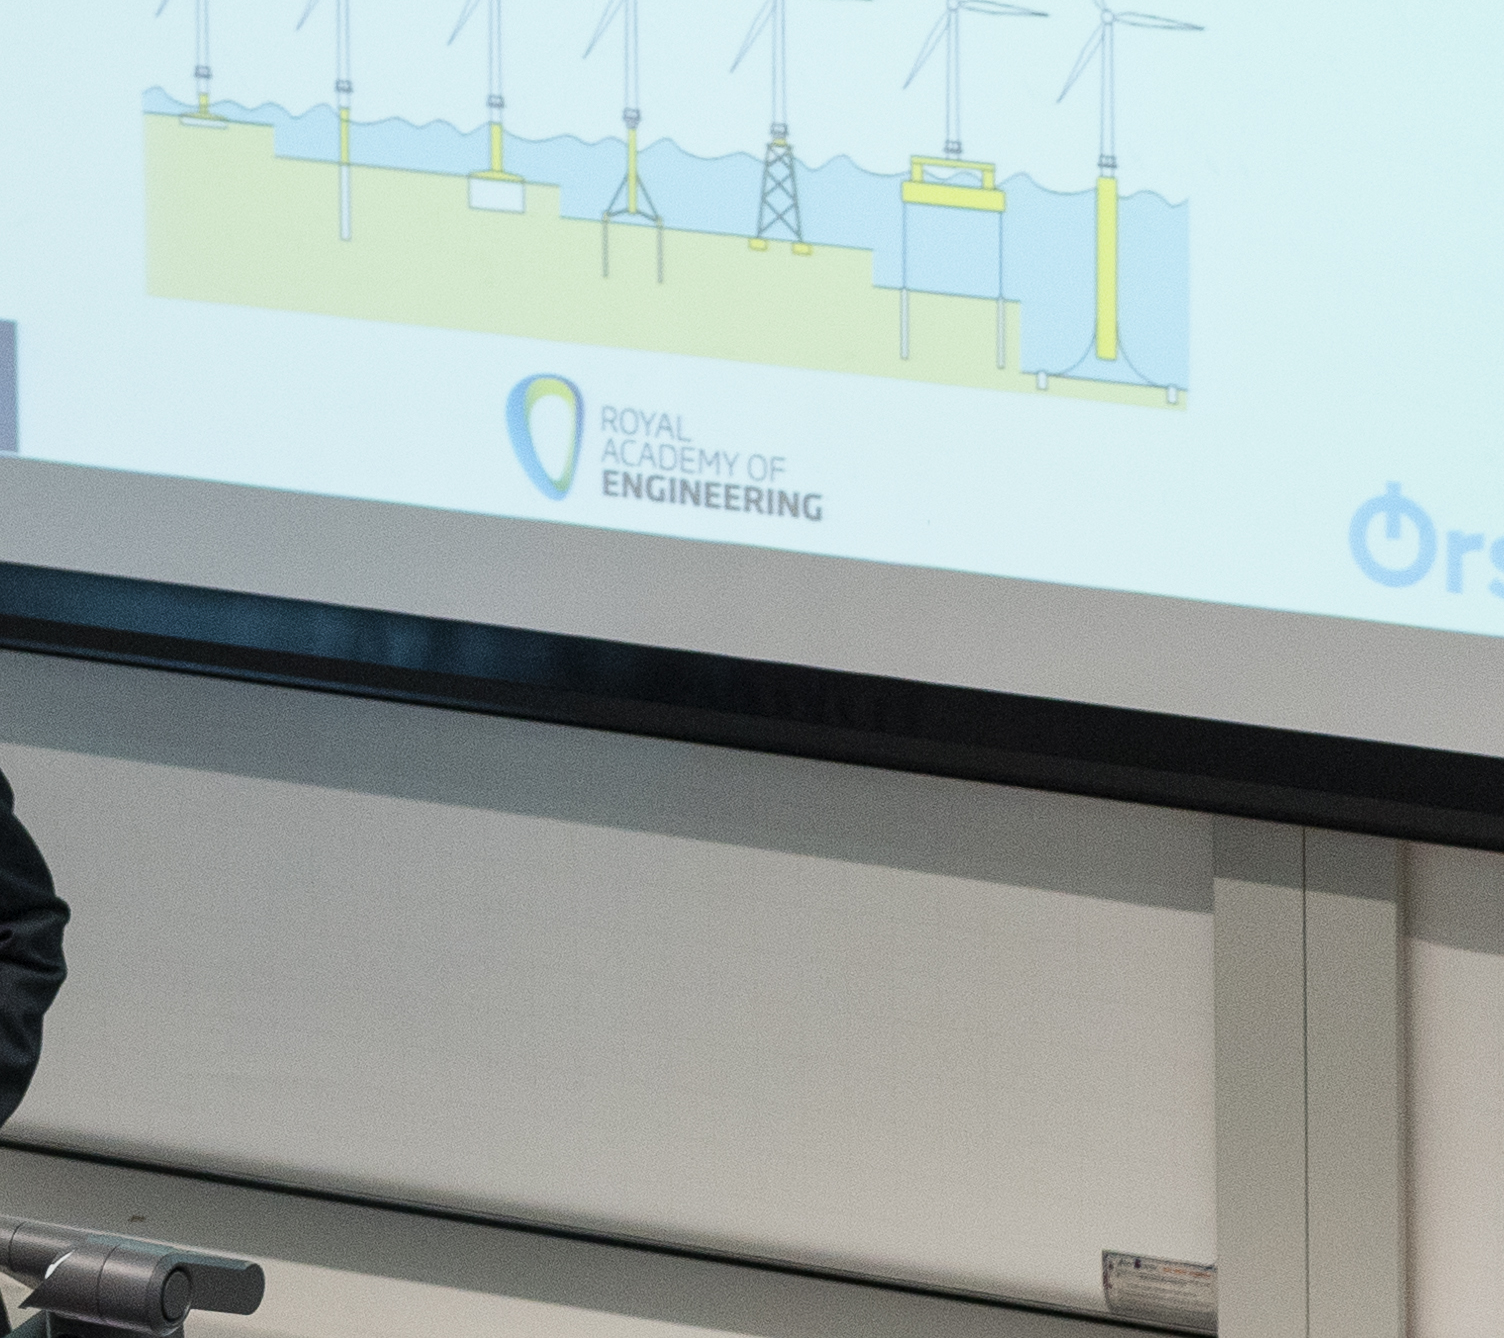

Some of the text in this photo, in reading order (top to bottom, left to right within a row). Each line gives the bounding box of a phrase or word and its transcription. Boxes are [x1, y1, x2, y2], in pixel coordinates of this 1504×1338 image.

[601, 406, 692, 442] ROYAL
[601, 438, 786, 482] ACADEMY OF
[602, 469, 823, 521] ENGINEERING
